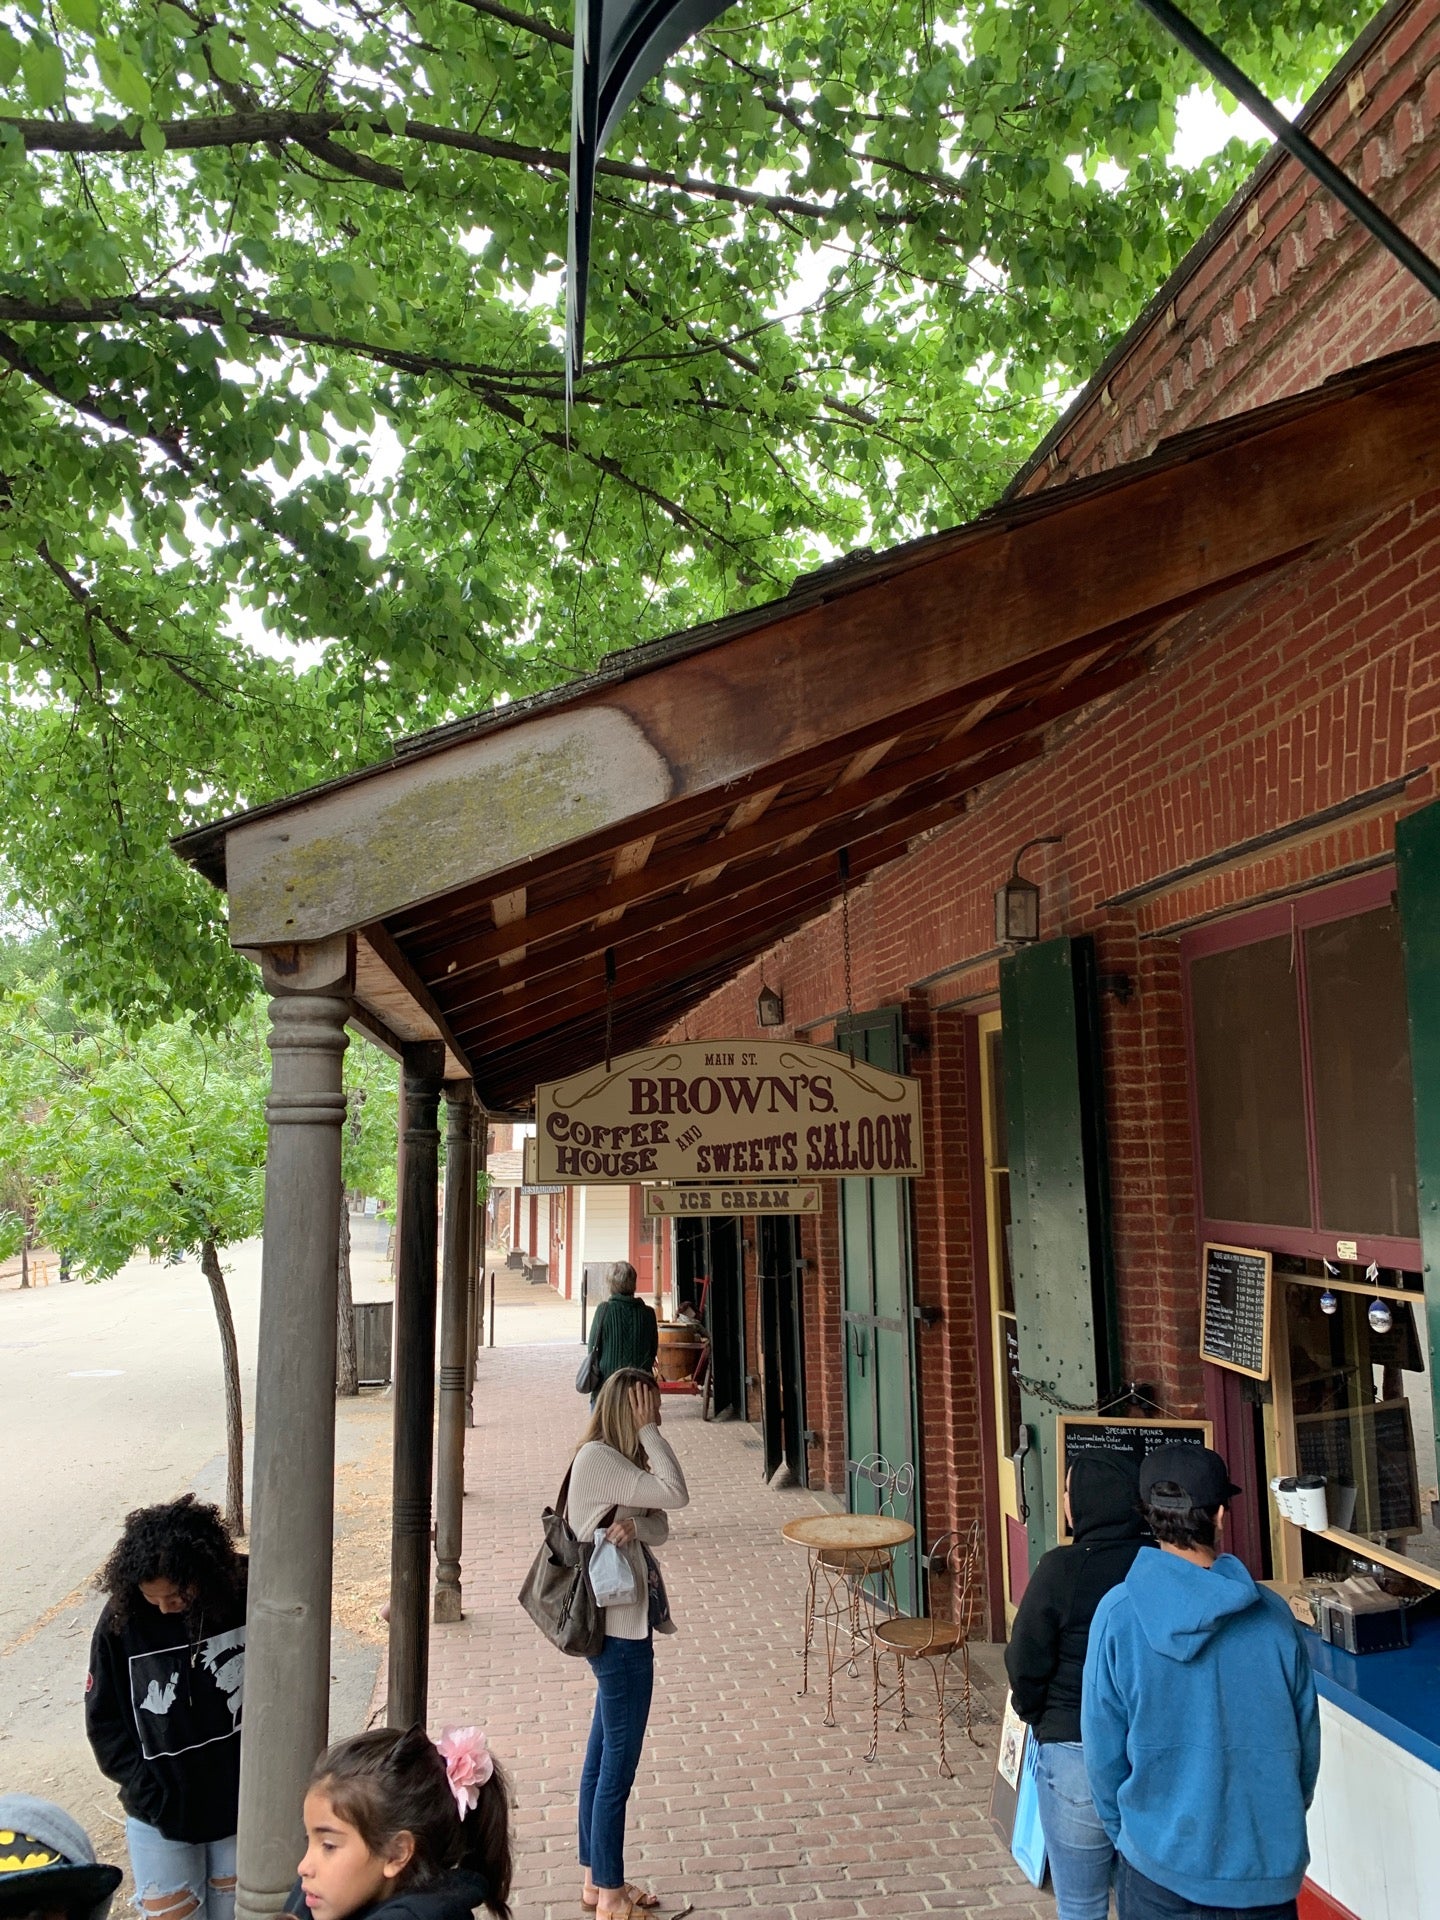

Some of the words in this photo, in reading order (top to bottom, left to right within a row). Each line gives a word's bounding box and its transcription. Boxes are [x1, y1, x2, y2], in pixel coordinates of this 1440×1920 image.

[705, 1053, 735, 1065] MAIN
[741, 1053, 758, 1065] ST.
[546, 1111, 670, 1150] COFFEE
[675, 1124, 703, 1152] AND
[697, 1131, 798, 1173] SWEETS
[806, 1113, 917, 1171] SALOON.
[556, 1145, 658, 1177] HOUSE
[521, 1185, 562, 1194] RESTAURANT
[679, 1192, 711, 1209] ICE
[721, 1190, 789, 1208] CREAM
[1140, 1428, 1163, 1436] DRINKS
